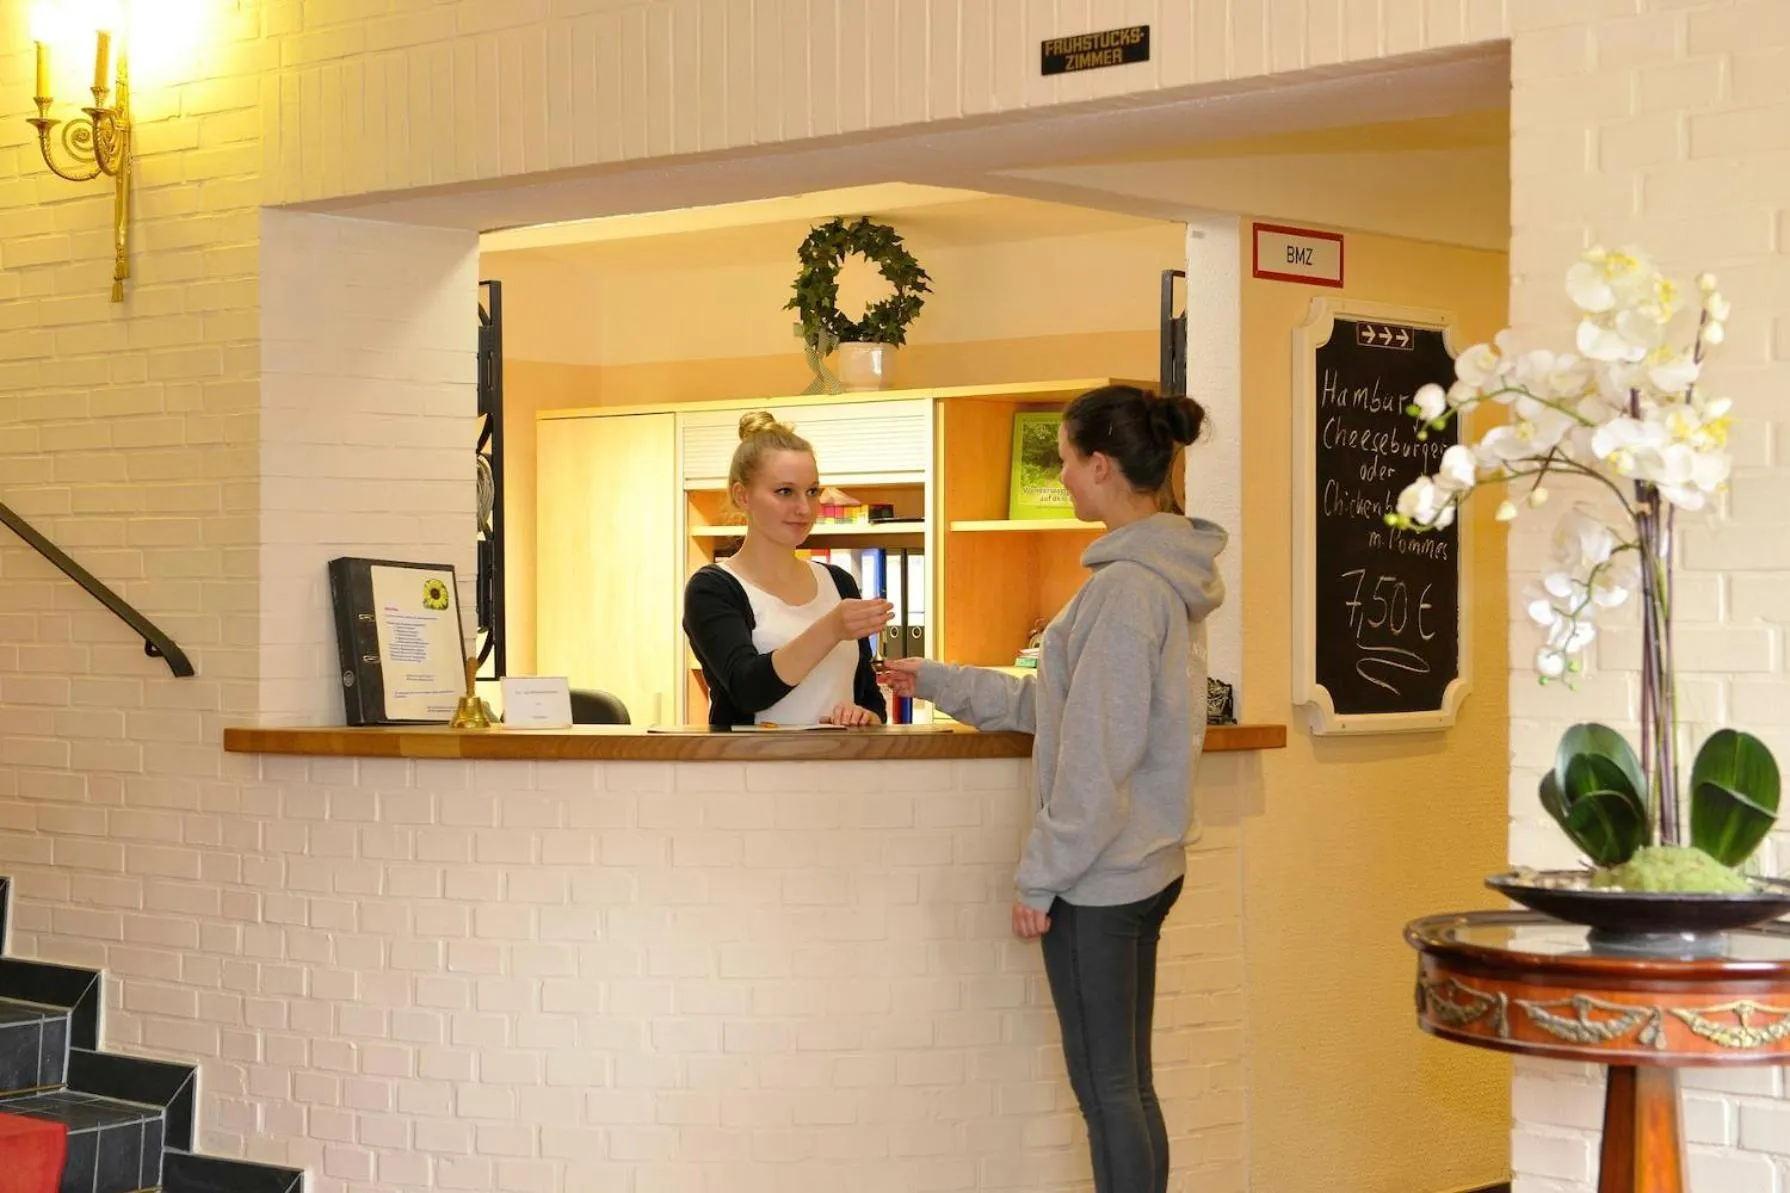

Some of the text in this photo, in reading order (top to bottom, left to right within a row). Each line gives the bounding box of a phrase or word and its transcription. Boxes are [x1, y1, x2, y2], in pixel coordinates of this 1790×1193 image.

[1064, 48, 1123, 70] ZIMMER
[1286, 245, 1313, 266] BMZ
[1321, 368, 1420, 431] Hambur
[1360, 455, 1396, 482] oder
[1324, 479, 1395, 518] Chickenb
